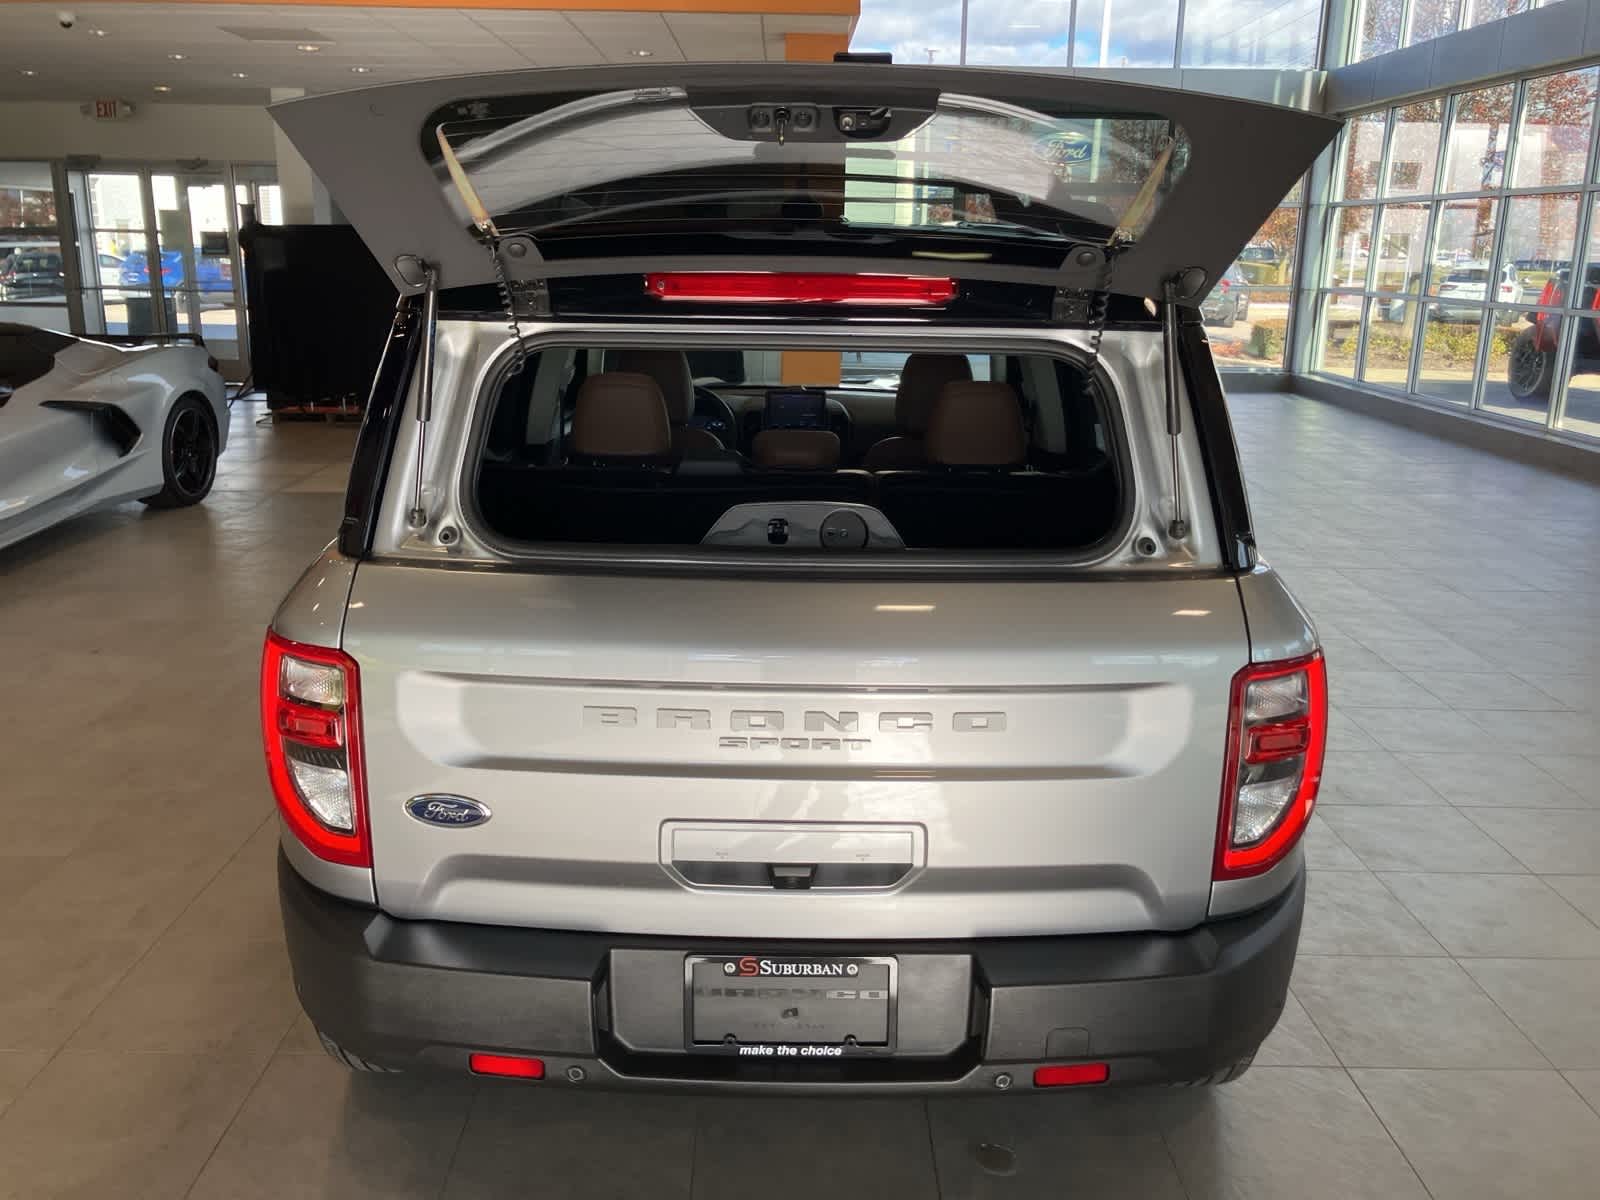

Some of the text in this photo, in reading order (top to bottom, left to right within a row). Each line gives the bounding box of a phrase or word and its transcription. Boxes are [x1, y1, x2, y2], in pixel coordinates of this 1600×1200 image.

[96, 100, 118, 118] EXIT
[1046, 140, 1088, 161] Ford
[583, 705, 1007, 732] BRONCO
[718, 736, 871, 751] SPORT
[424, 801, 470, 821] Ford
[739, 1045, 842, 1056] make the choice
